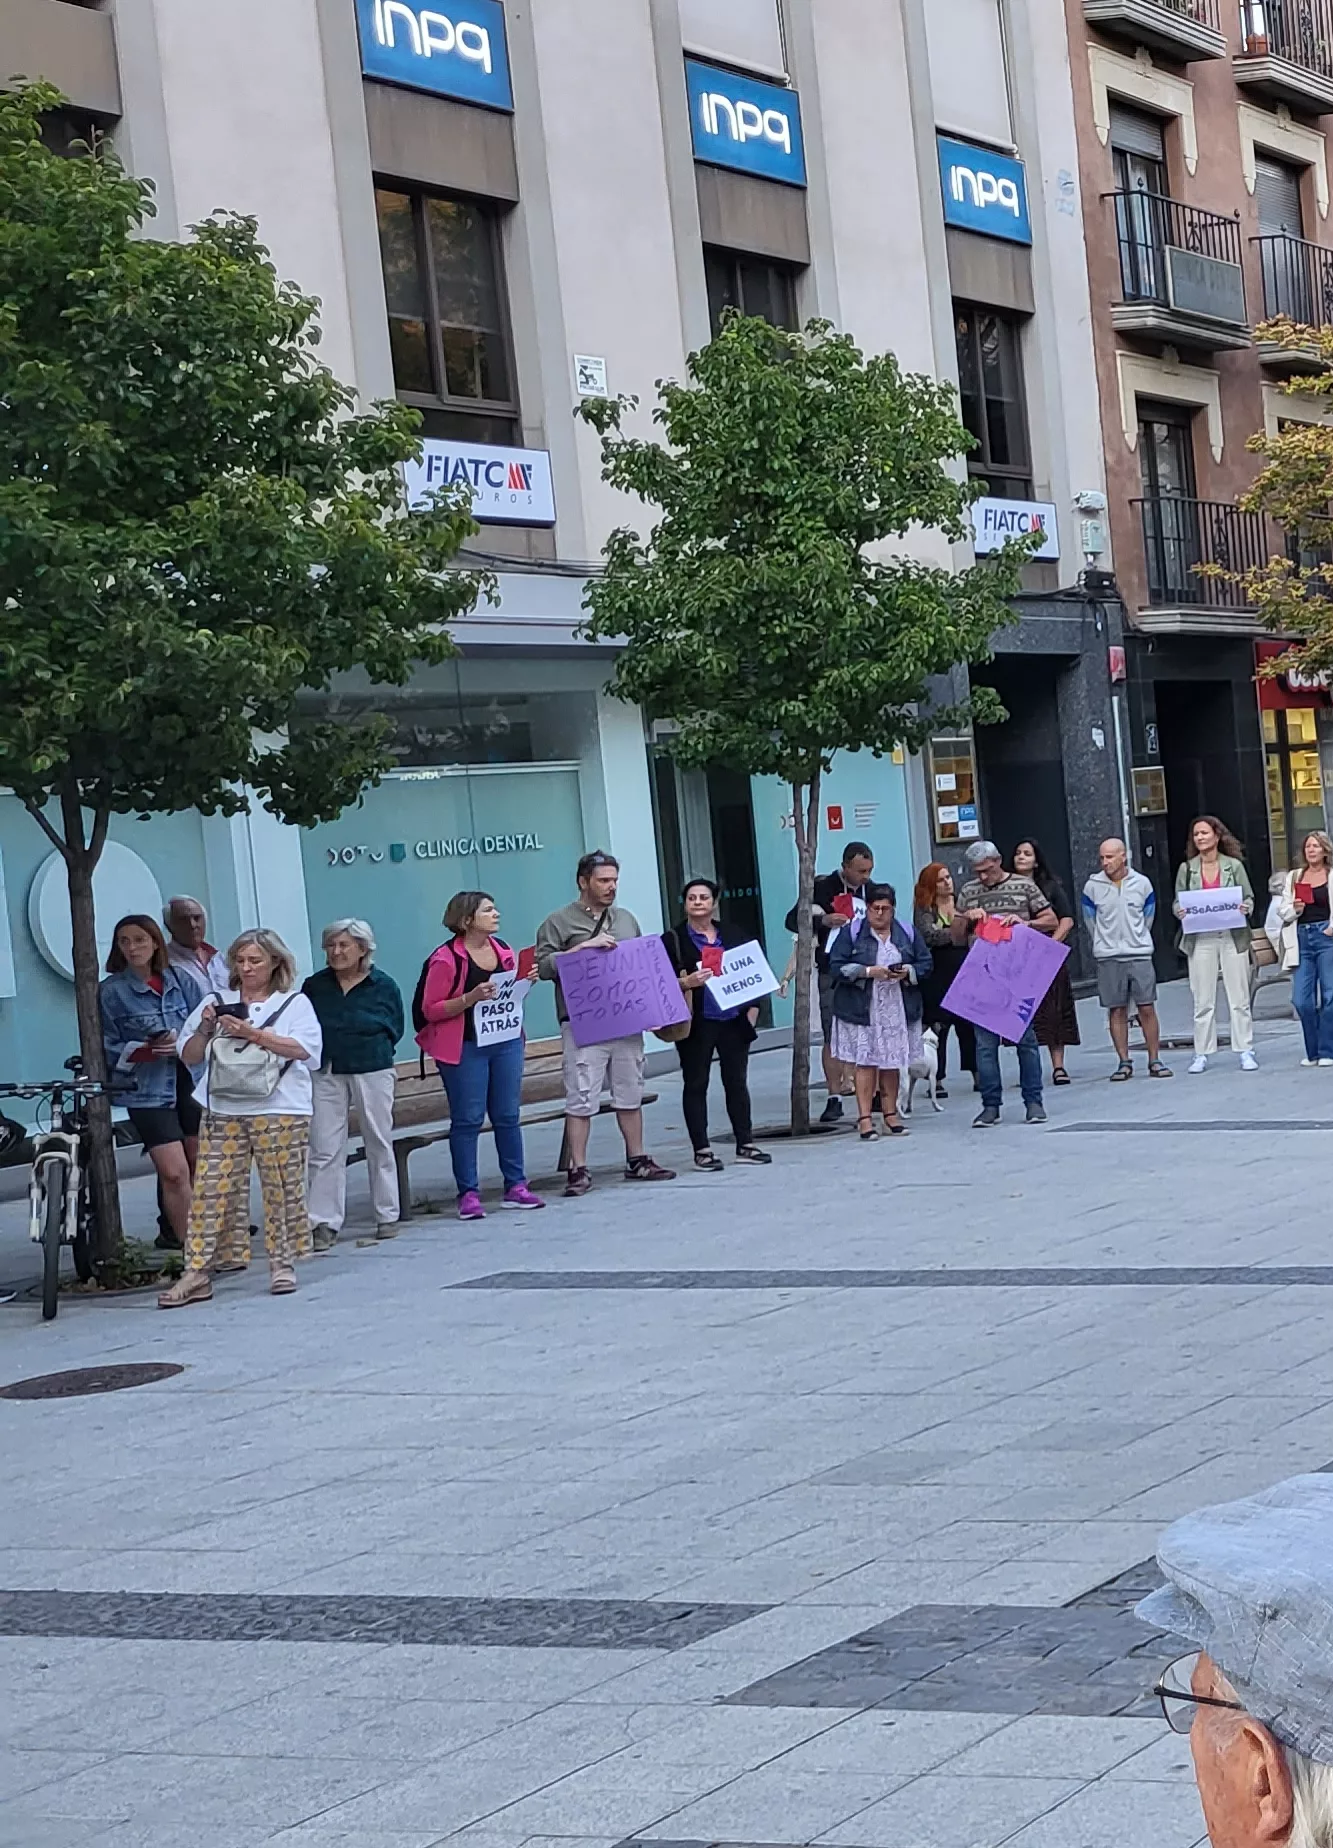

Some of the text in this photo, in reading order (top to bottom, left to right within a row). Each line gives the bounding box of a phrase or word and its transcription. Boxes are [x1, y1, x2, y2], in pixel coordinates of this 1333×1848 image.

[484, 832, 545, 854] DENTAL
[1185, 901, 1239, 916] #SeAcabó
[729, 955, 755, 973] UNA
[567, 976, 651, 1008] SOMOS
[721, 973, 763, 996] MENOS
[481, 1001, 515, 1018] PASO
[571, 997, 648, 1021] TODAS
[480, 1013, 520, 1035] ATRÁS
